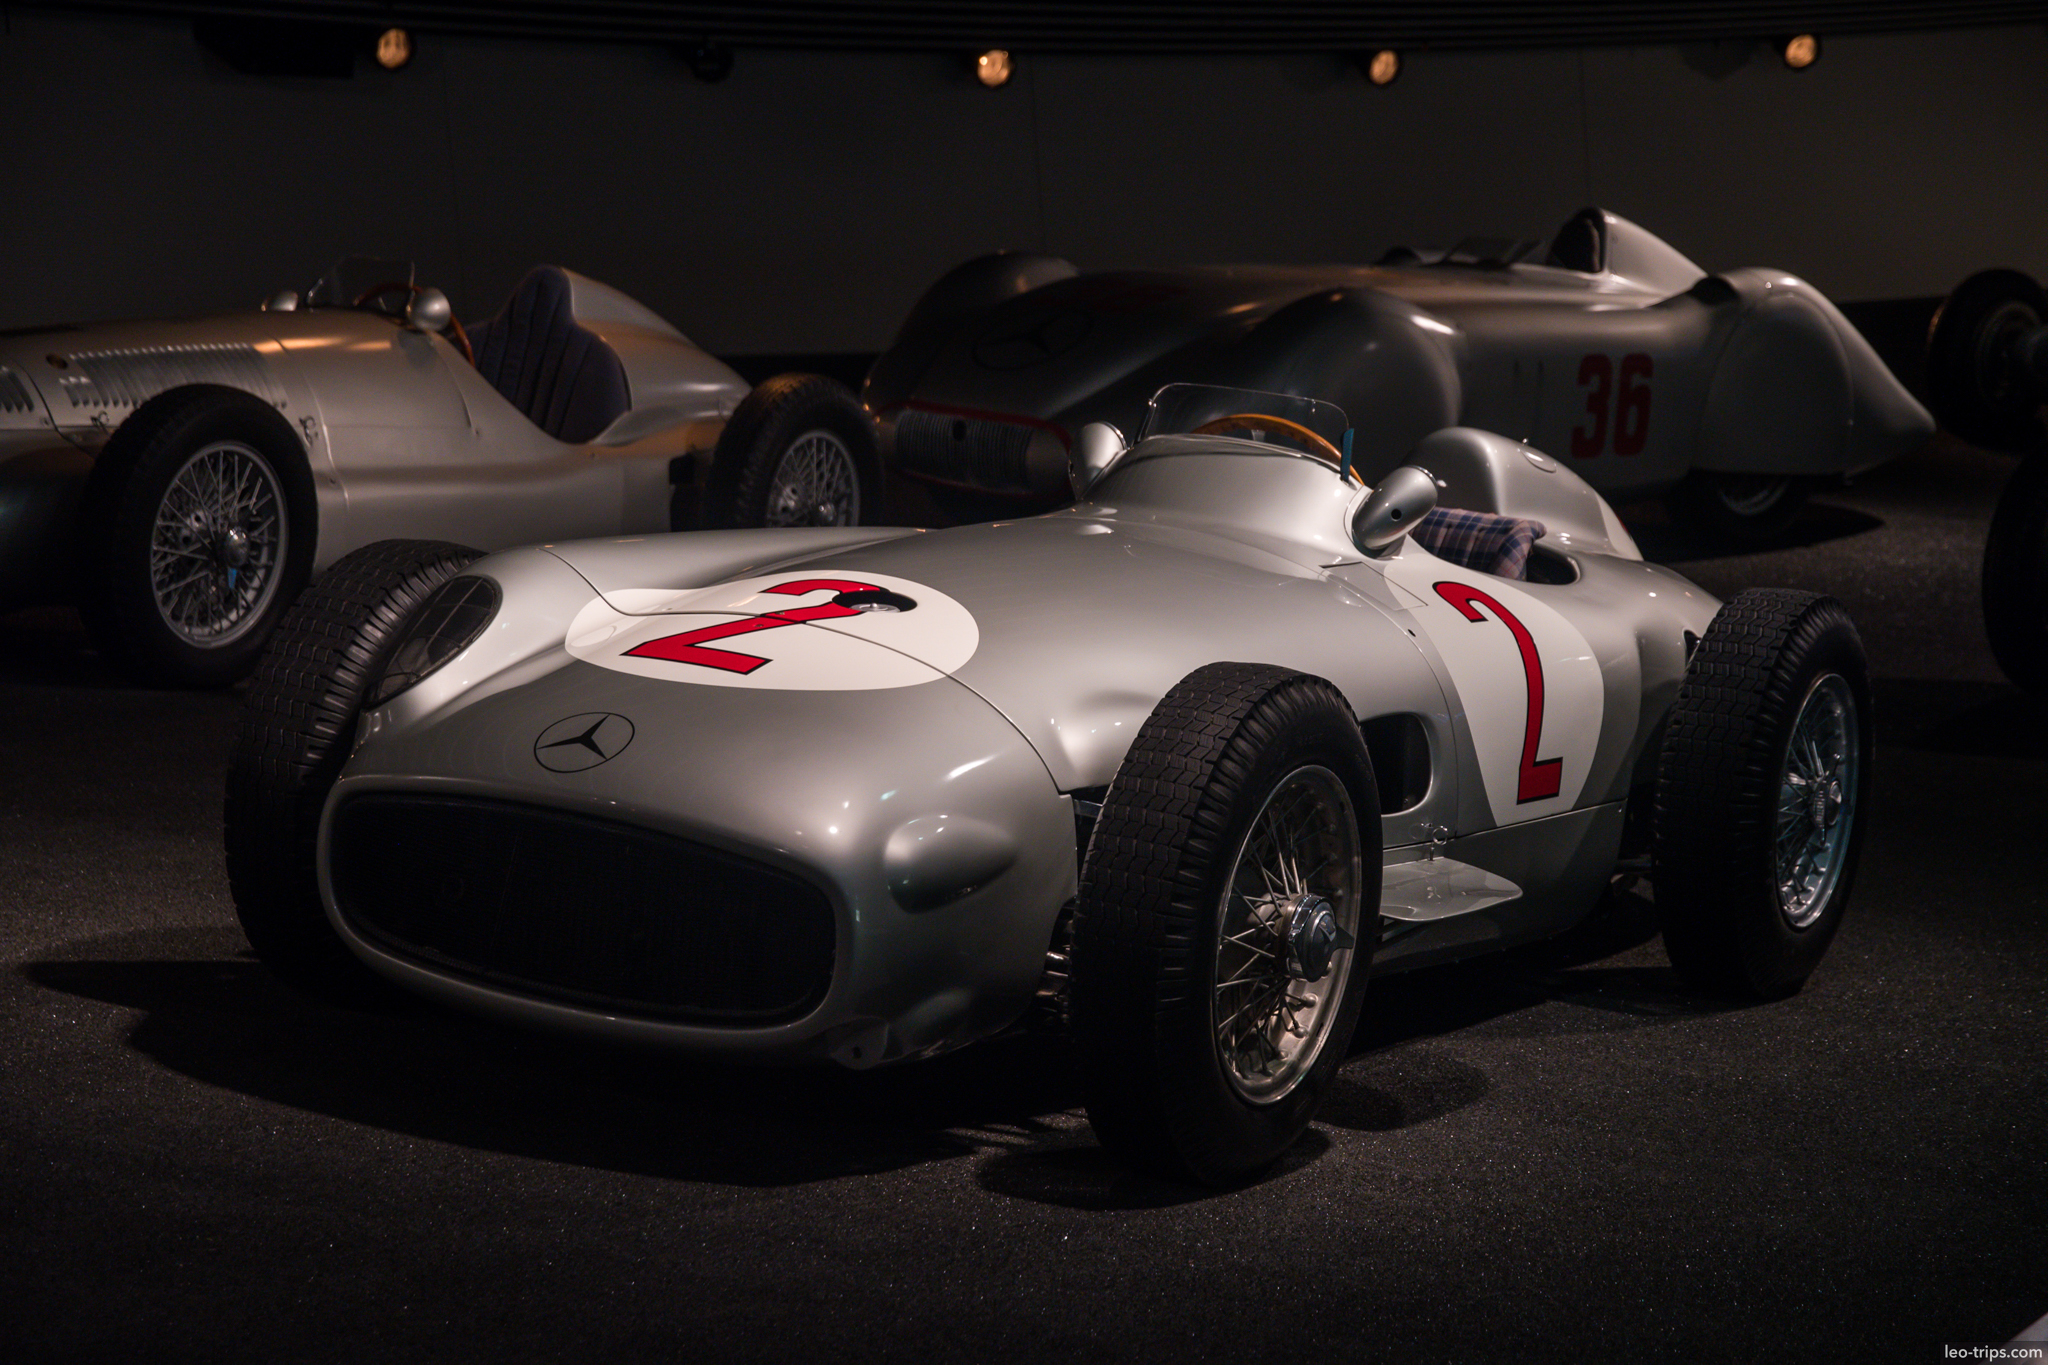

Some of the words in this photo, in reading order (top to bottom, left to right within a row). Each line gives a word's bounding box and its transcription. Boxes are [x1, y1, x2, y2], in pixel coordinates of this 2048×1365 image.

[1572, 353, 1653, 459] 36
[621, 579, 892, 675] 2
[1432, 581, 1563, 805] 2
